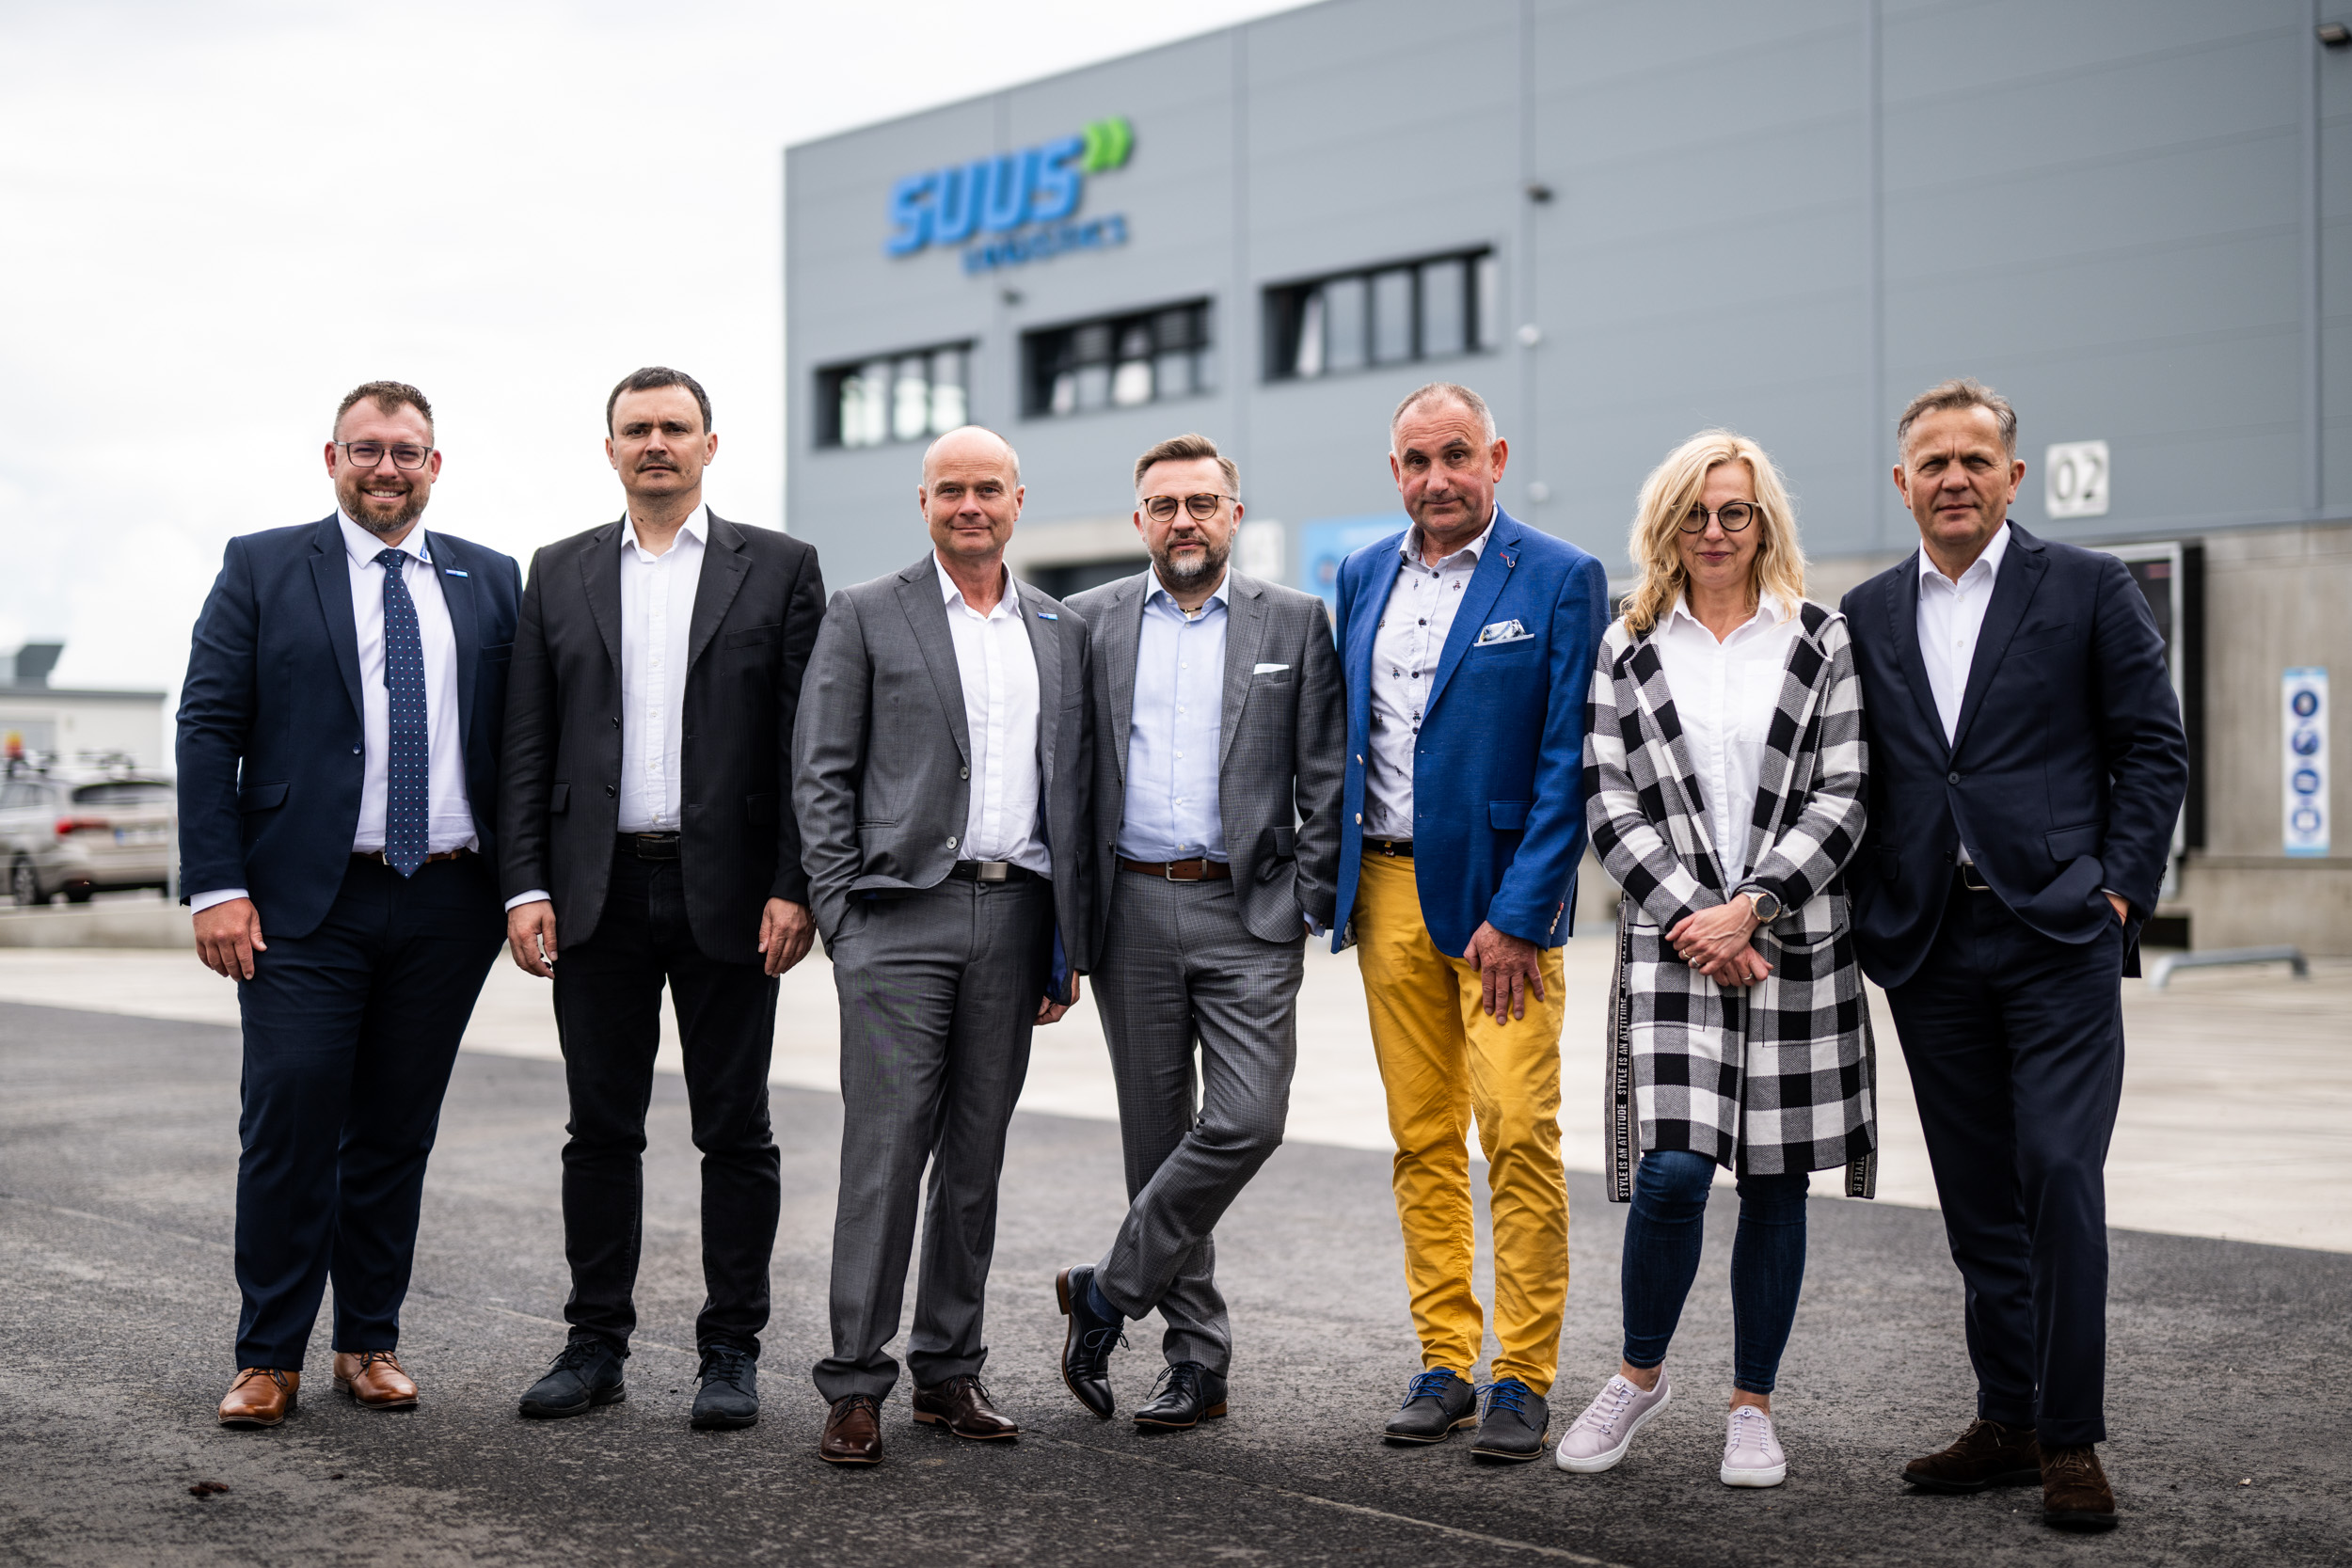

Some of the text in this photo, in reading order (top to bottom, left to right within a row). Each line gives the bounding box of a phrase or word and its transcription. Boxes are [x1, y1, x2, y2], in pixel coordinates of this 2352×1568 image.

[884, 135, 1084, 257] SUUS
[2052, 450, 2105, 506] 02
[1618, 1043, 1629, 1054] AN
[1618, 1057, 1628, 1066] IS
[1617, 1068, 1628, 1095] STYLE
[1617, 1103, 1629, 1197] STYLE IS AN ATTITUDE
[1853, 1183, 1863, 1192] IS
